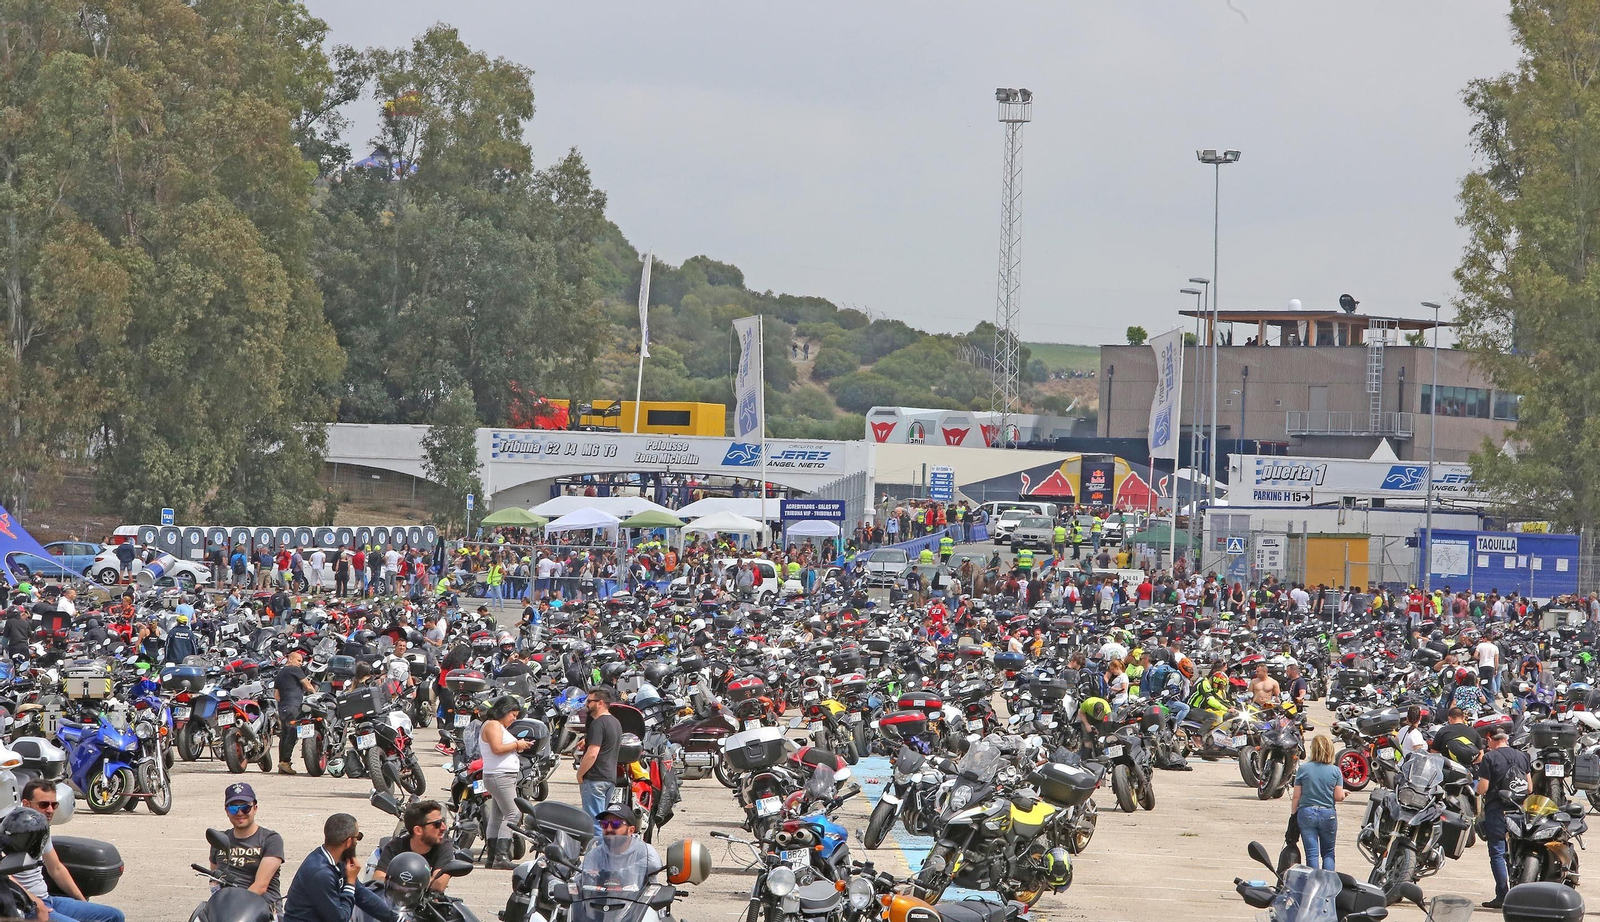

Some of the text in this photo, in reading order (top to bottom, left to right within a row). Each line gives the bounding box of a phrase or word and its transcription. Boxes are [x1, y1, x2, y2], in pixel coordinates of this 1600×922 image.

[499, 439, 618, 457] Tribuna C2 J4 M6 T8
[646, 440, 690, 451] Pelousse
[634, 452, 700, 464] Zona Michelin
[770, 450, 832, 461] JEREZ
[766, 460, 796, 468] ÁNGEL
[1261, 463, 1328, 486] puerta 1
[1253, 490, 1301, 502] PARKING H 15
[1478, 538, 1516, 551] TAQUILLA
